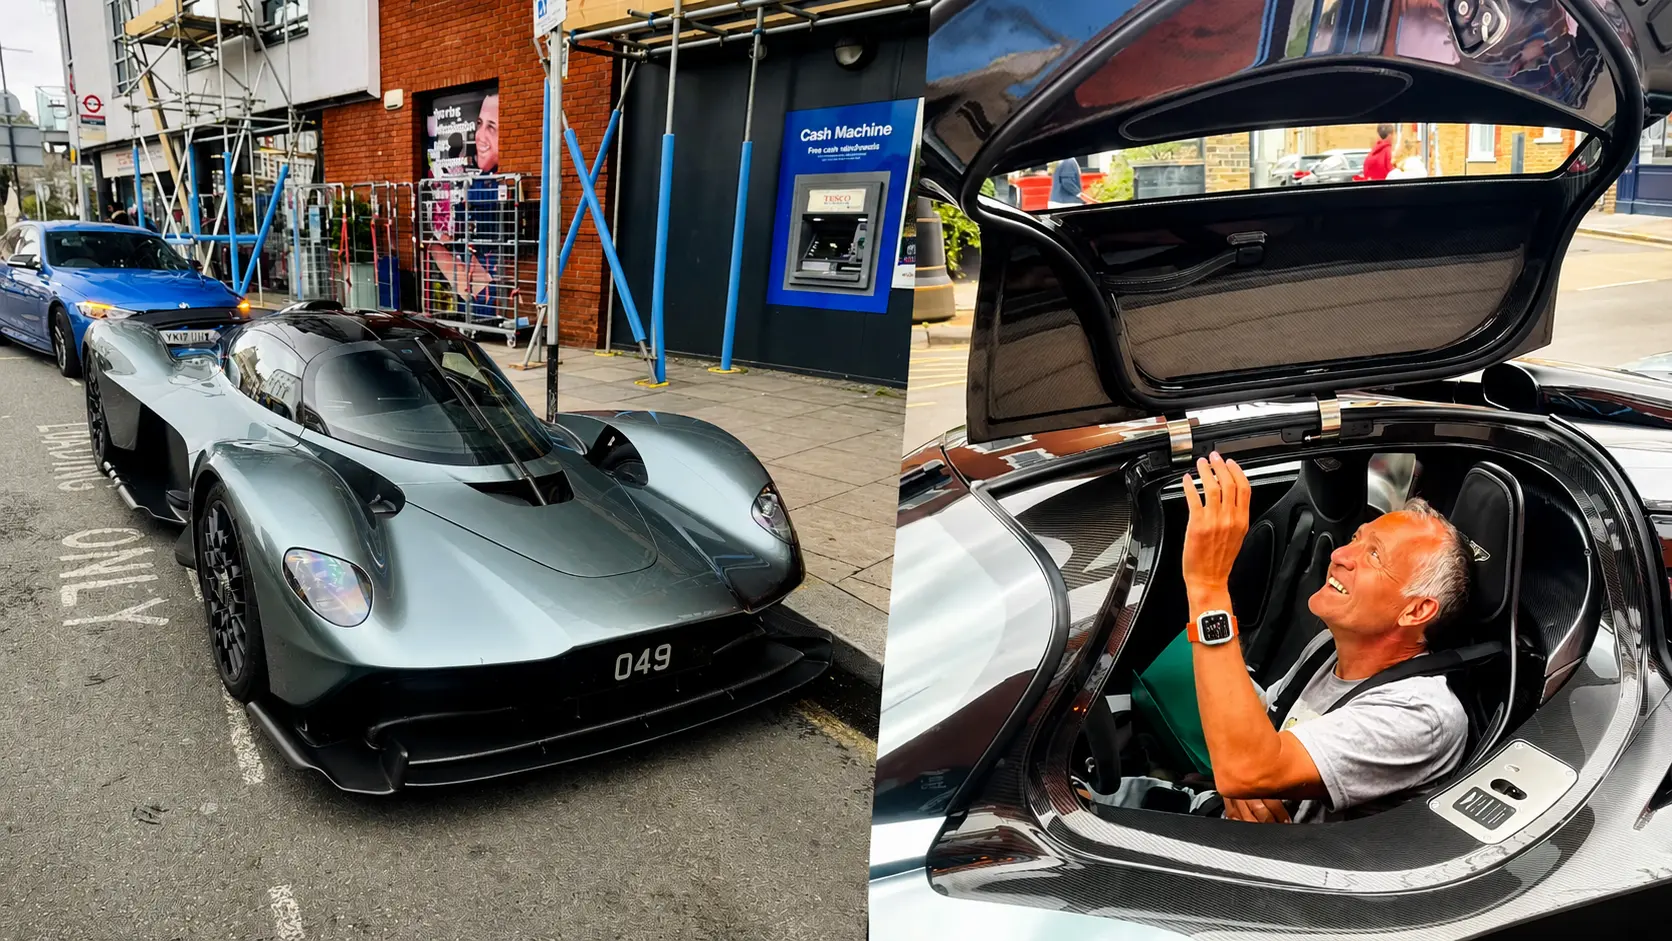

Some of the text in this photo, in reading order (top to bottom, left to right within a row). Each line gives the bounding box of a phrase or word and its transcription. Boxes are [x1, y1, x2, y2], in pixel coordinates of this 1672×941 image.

[800, 122, 893, 142] Cash Machine
[824, 194, 851, 202] TESCO
[59, 527, 170, 627] ONLY
[614, 643, 672, 681] 049
